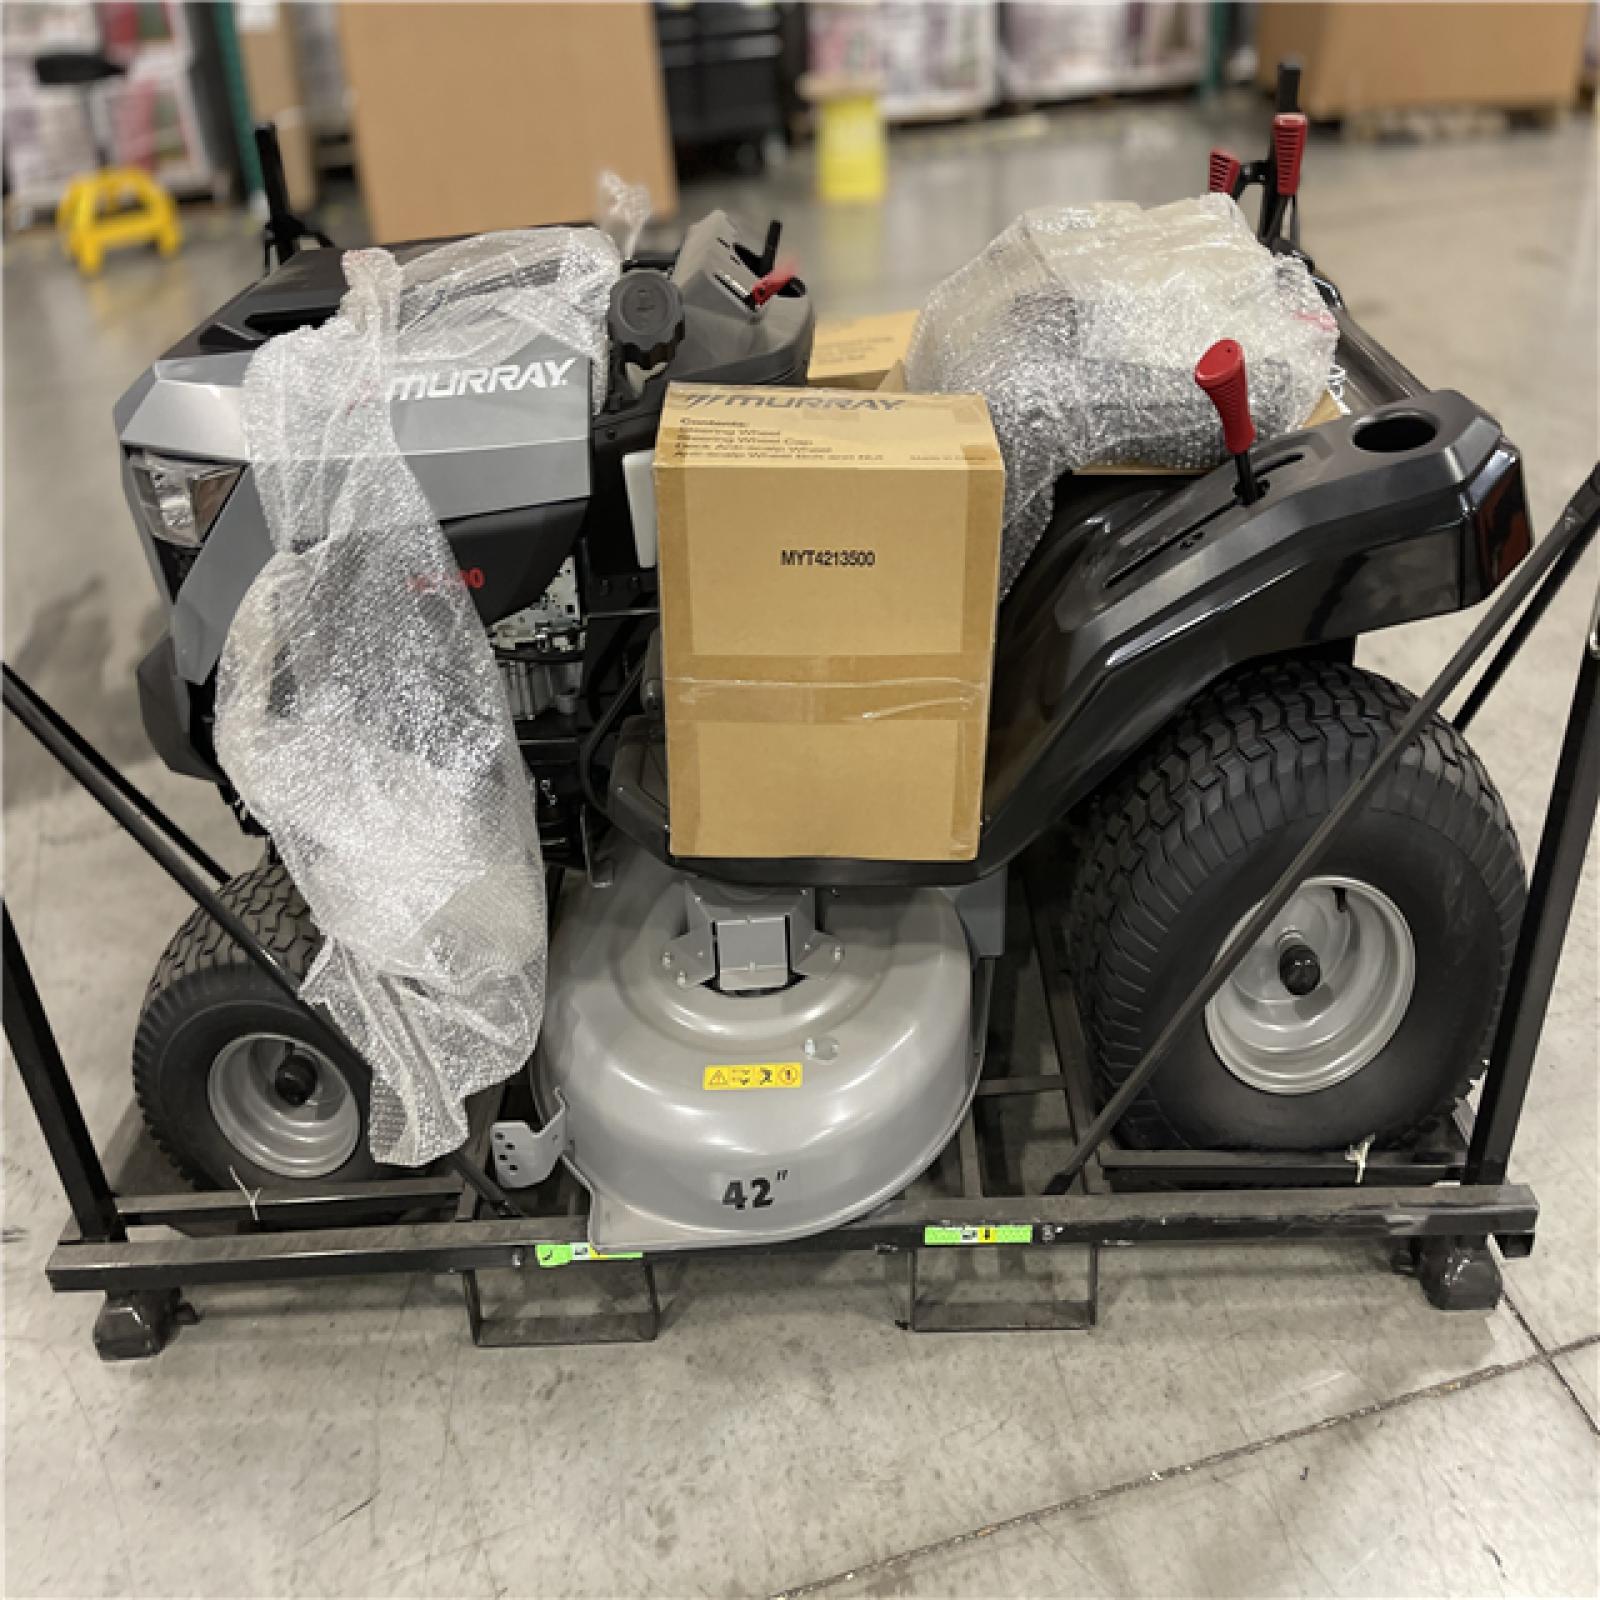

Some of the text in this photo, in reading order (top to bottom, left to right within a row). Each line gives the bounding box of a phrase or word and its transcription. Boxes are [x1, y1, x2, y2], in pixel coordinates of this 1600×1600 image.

[385, 357, 578, 401] MURRAY
[722, 394, 906, 411] MURRAY
[780, 549, 876, 566] MYT4213500
